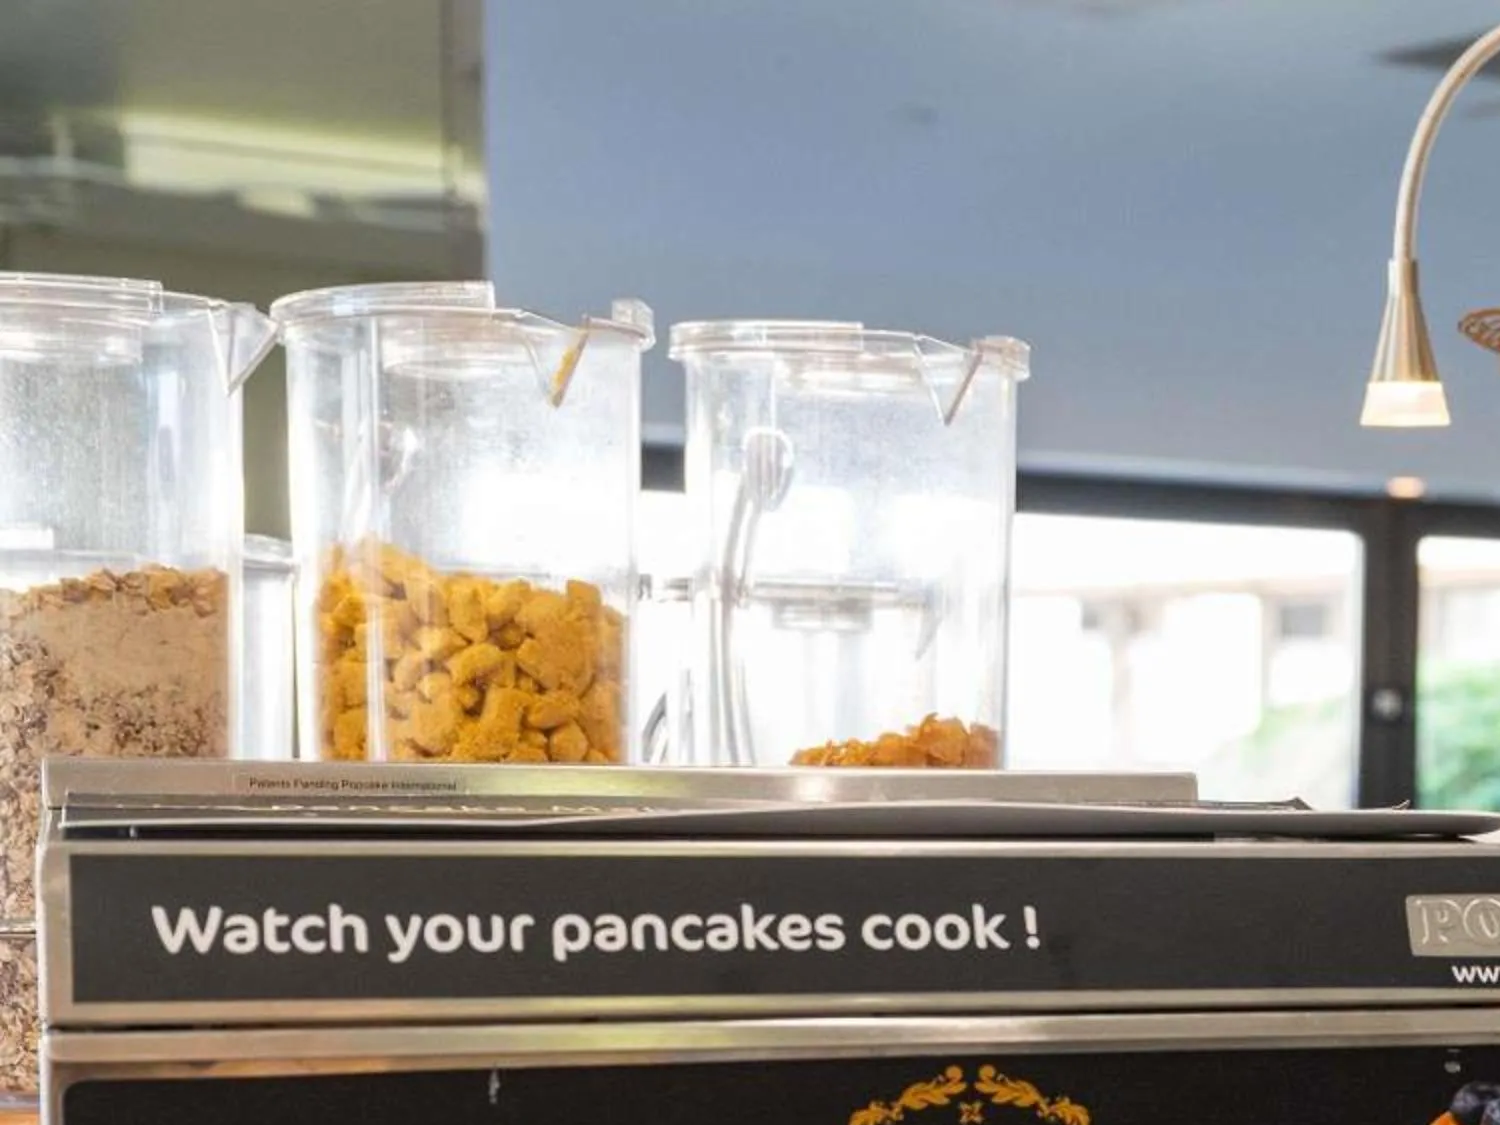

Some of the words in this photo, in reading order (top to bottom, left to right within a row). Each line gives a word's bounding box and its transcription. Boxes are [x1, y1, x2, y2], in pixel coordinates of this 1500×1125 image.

[250, 777, 291, 788] Patents
[152, 903, 369, 954] Watch
[385, 913, 535, 963] your
[552, 903, 846, 962] pancakes
[861, 903, 1011, 951] cook
